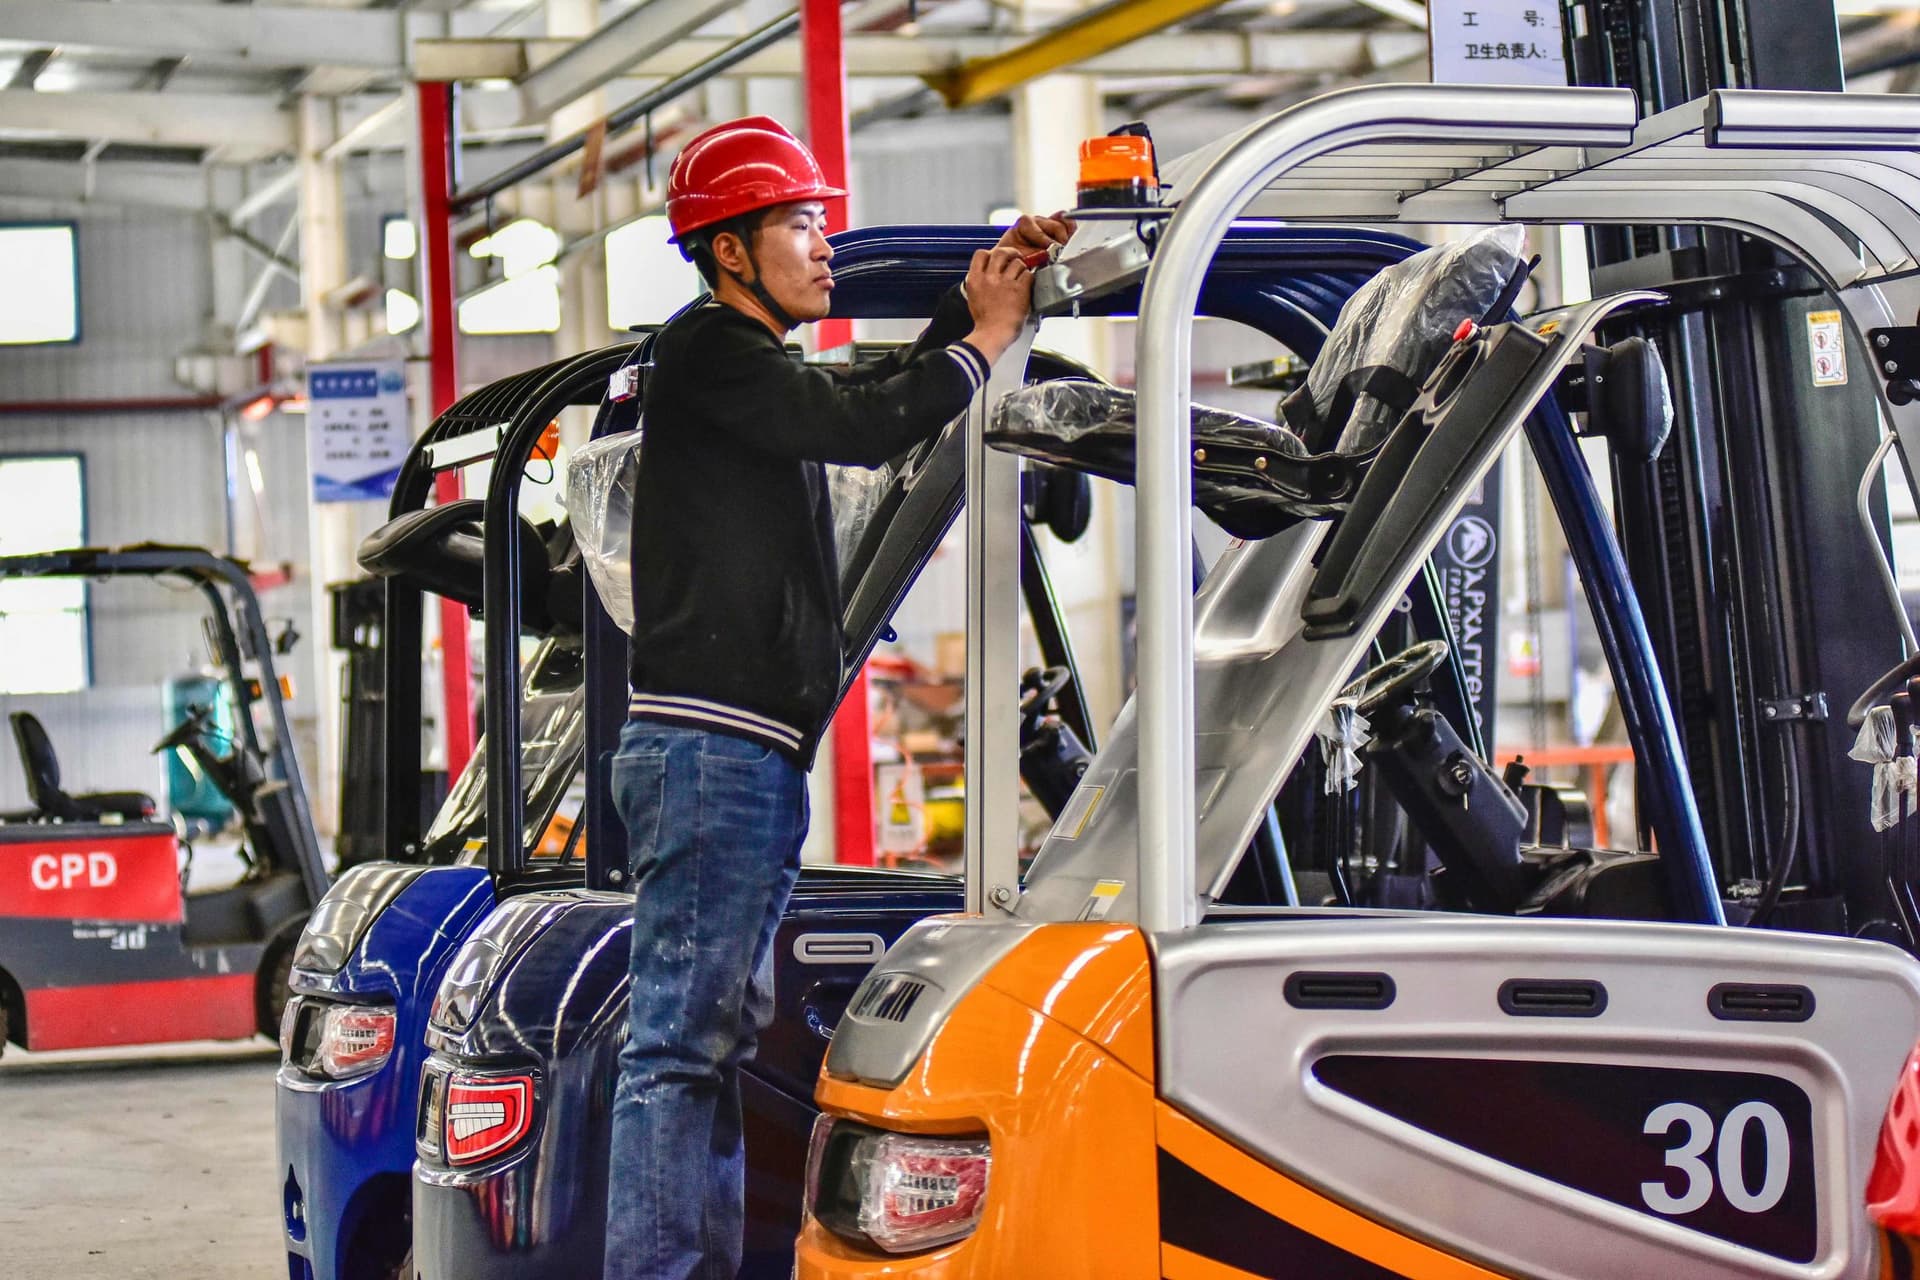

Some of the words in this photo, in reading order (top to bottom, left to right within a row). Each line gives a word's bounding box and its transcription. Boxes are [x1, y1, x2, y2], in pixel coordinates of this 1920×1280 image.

[1463, 11, 1479, 26] 工
[31, 852, 118, 890] CPD
[1640, 1101, 1791, 1215] 30
